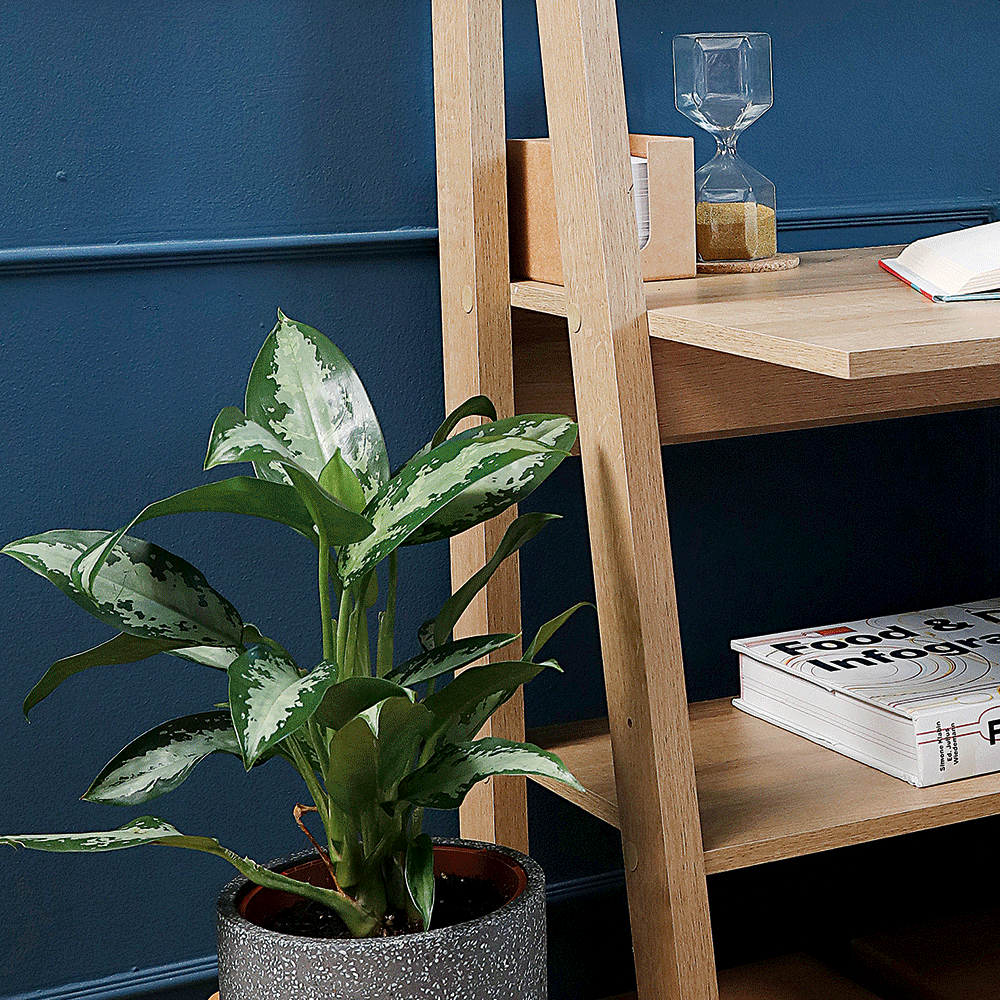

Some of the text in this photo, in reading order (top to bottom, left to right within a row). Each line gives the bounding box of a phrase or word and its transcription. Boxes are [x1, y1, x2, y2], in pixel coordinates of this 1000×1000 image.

[770, 625, 921, 656] Food
[923, 618, 975, 632] &
[951, 722, 959, 765] Wiedemann
